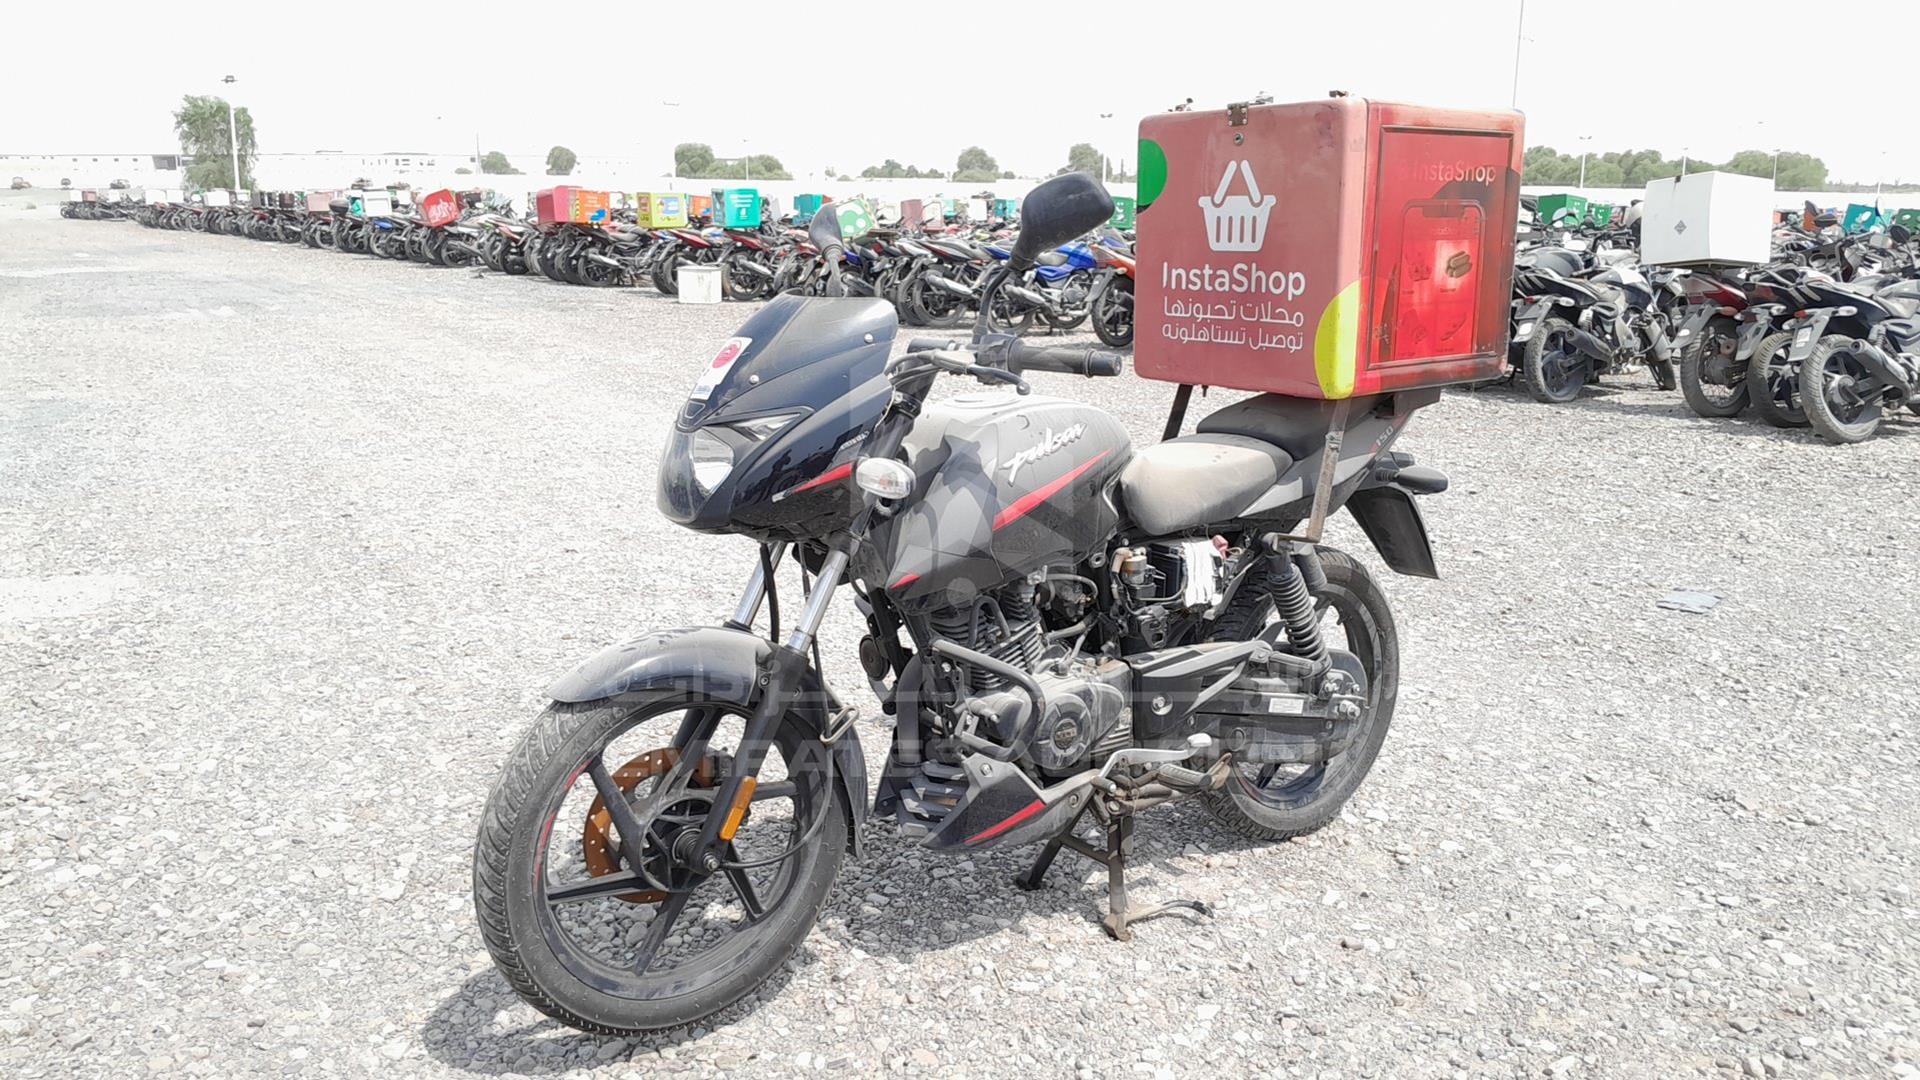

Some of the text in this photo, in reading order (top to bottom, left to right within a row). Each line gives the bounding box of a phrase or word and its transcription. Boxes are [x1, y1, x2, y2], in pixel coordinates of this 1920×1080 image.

[1162, 261, 1306, 301] InstaShop
[1239, 301, 1305, 328] محلات
[1375, 425, 1394, 447] 150
